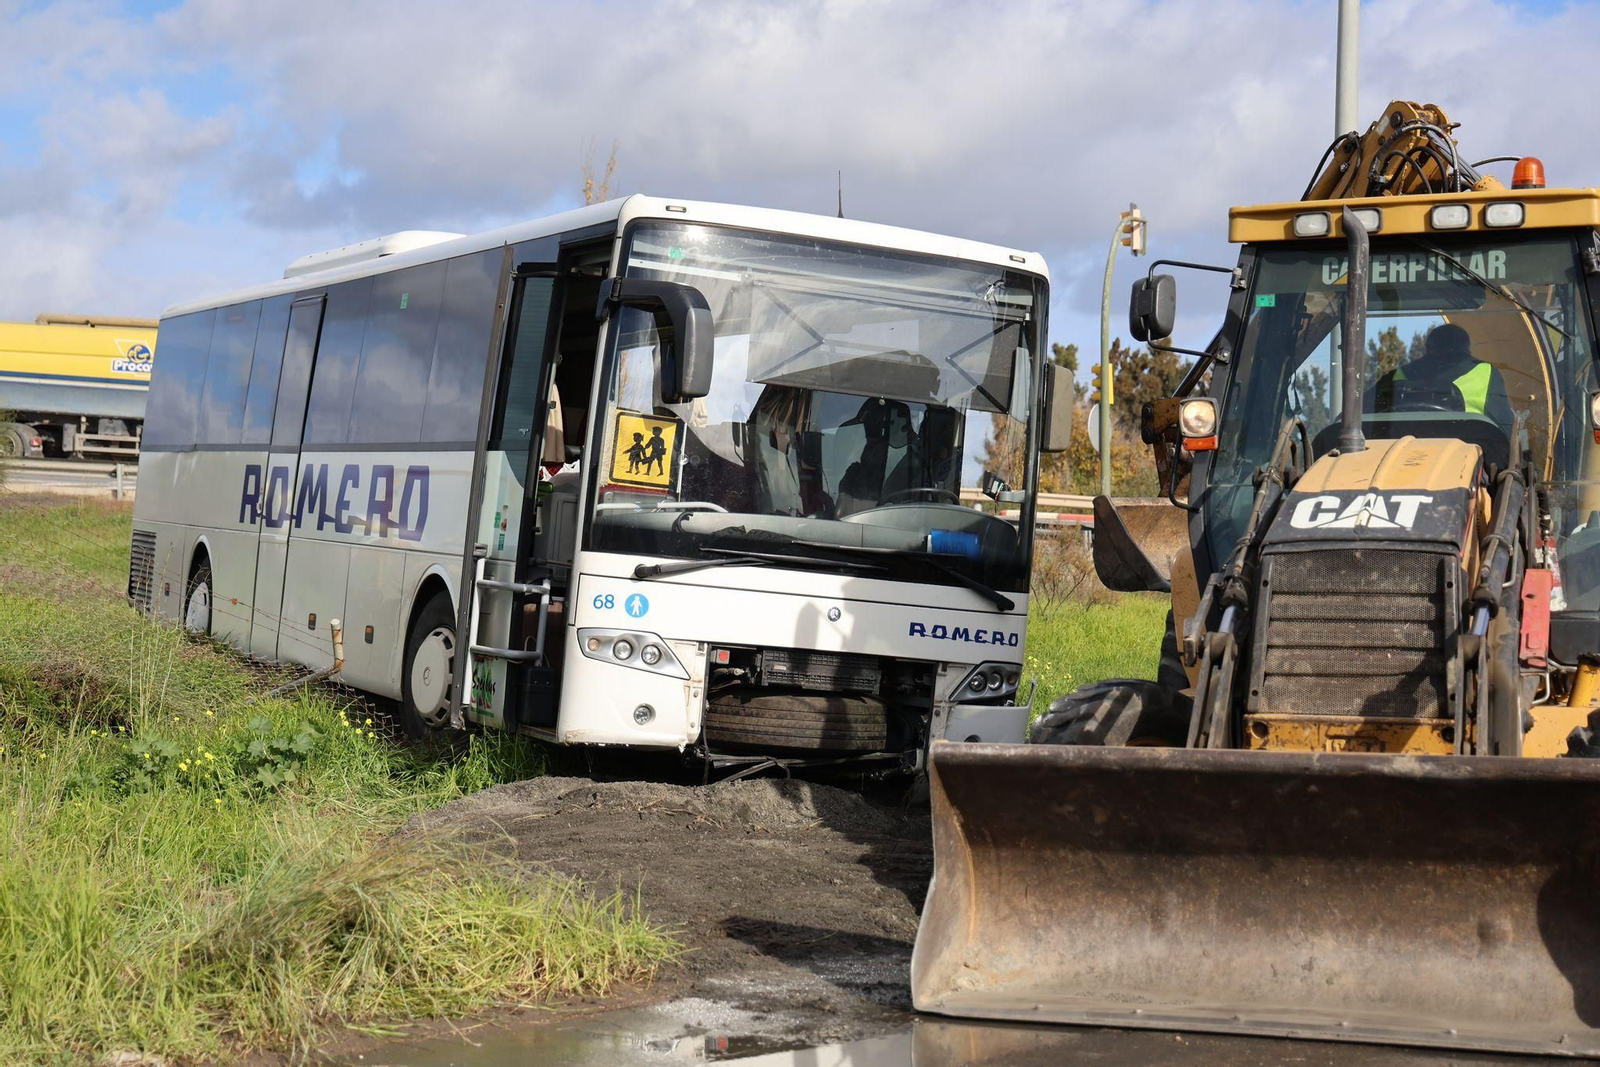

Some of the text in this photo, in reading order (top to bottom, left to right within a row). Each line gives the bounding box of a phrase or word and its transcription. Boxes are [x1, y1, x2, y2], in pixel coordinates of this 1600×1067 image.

[1321, 250, 1507, 285] CAERPILLAR
[113, 360, 152, 372] Proca
[239, 463, 430, 542] ROMERO
[1290, 493, 1433, 531] CAT
[593, 594, 615, 610] 68
[908, 622, 1019, 647] ROMERO
